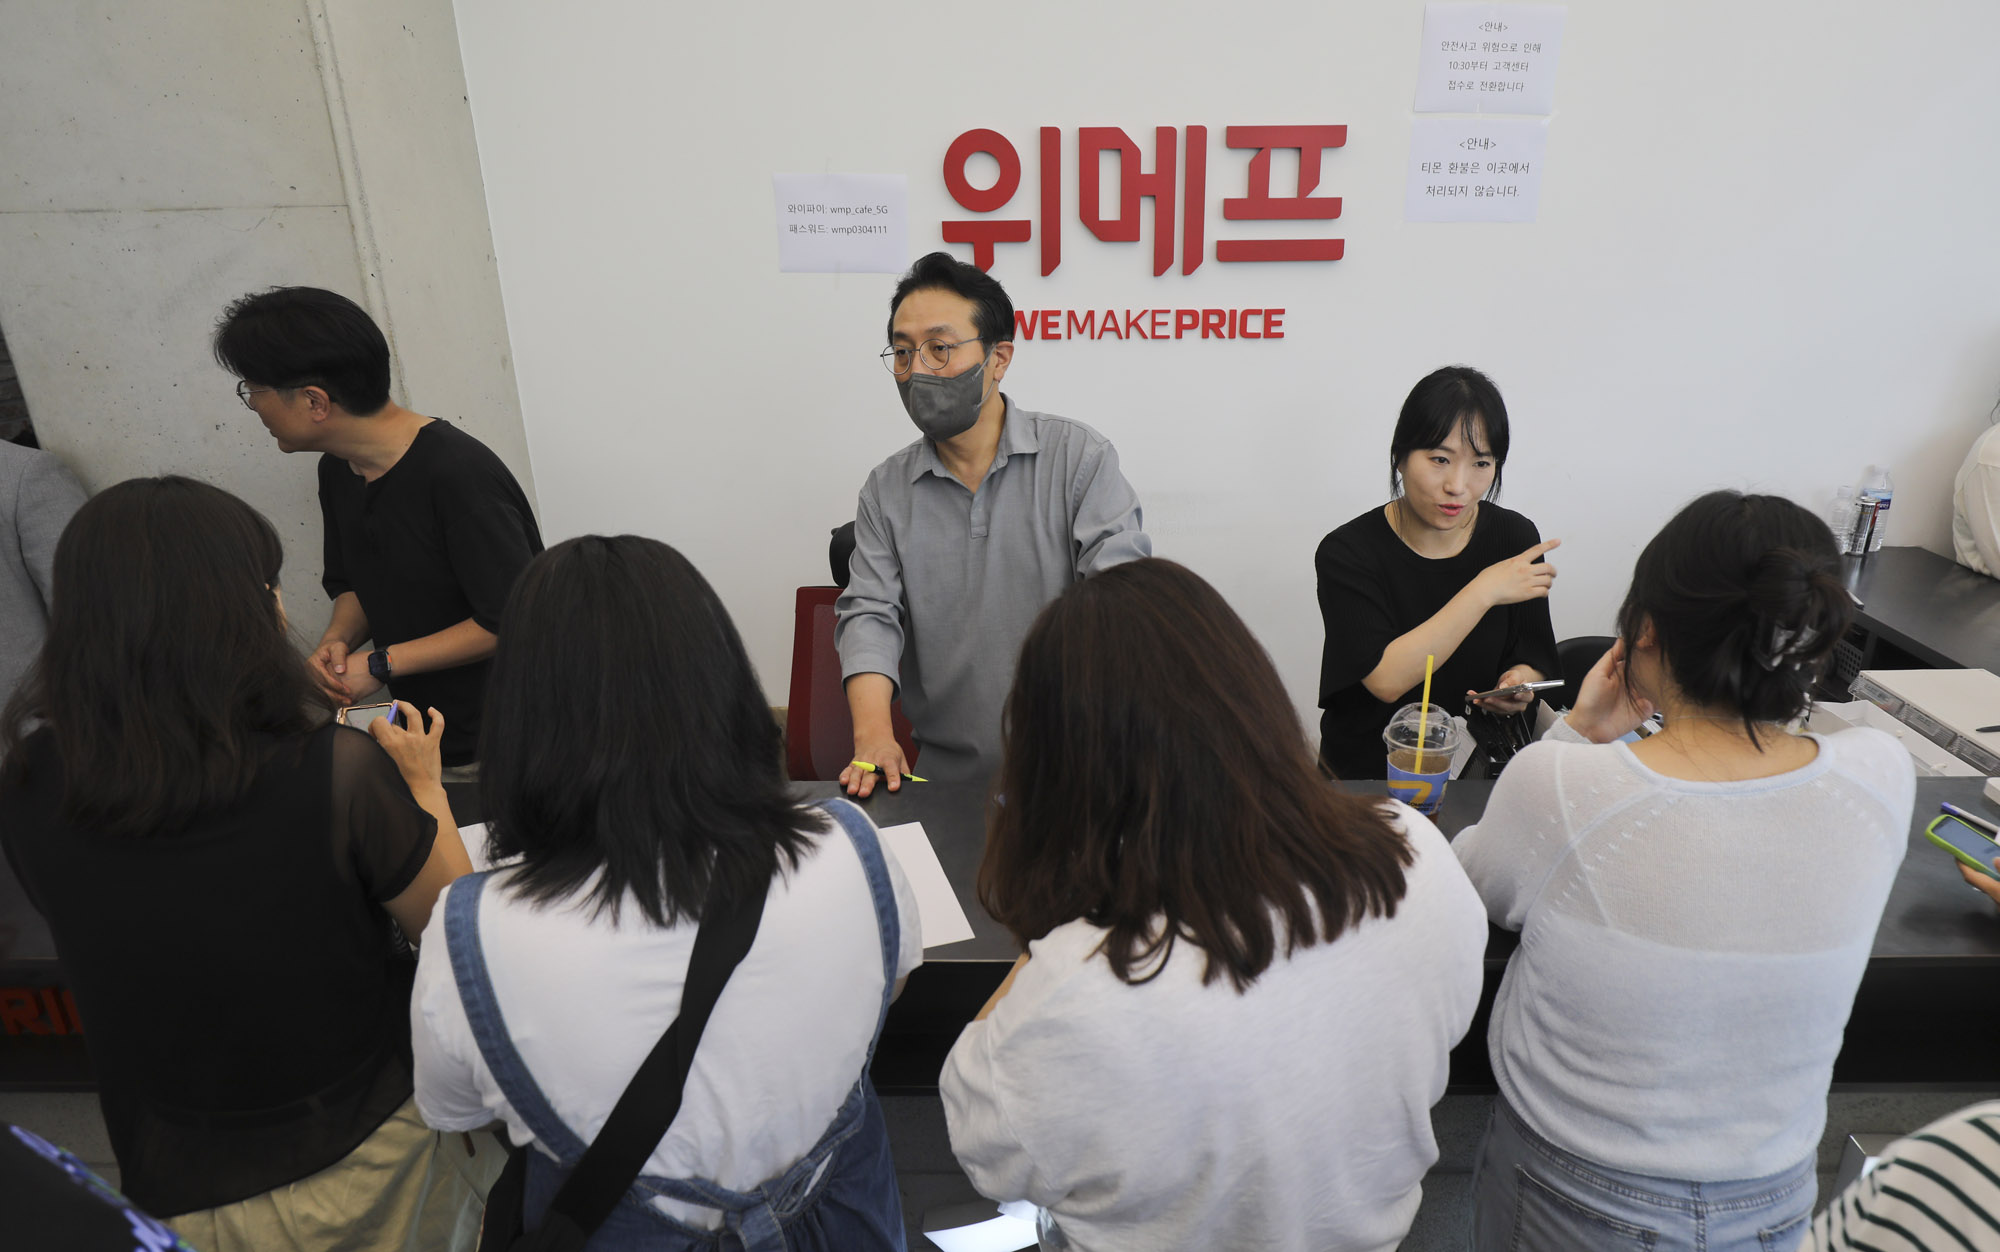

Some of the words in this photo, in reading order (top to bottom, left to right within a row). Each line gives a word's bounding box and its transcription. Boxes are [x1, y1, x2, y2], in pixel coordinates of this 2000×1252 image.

[1478, 21, 1509, 32] <안내>
[1441, 41, 1477, 52] 안전사고
[1482, 42, 1518, 53] 위험으로
[1523, 42, 1541, 54] 인해
[1449, 61, 1488, 72] 10:30부터
[1493, 61, 1529, 73] 고객센터
[1448, 80, 1474, 91] 접수로
[1479, 81, 1525, 92] 전환합니다
[1459, 137, 1497, 150] <안내>
[1421, 162, 1443, 174] 티몬
[1448, 162, 1481, 174] 환불은
[1486, 162, 1530, 174] 이곳에서
[1425, 185, 1468, 197] 처리되지
[1474, 185, 1520, 198] 않습니다.
[942, 125, 1348, 277] 위메프
[787, 204, 828, 214] 와이파이:
[830, 205, 888, 216] wmp_cafe_5G
[789, 224, 829, 234] 패스워드:
[831, 225, 888, 236] wmp0304111
